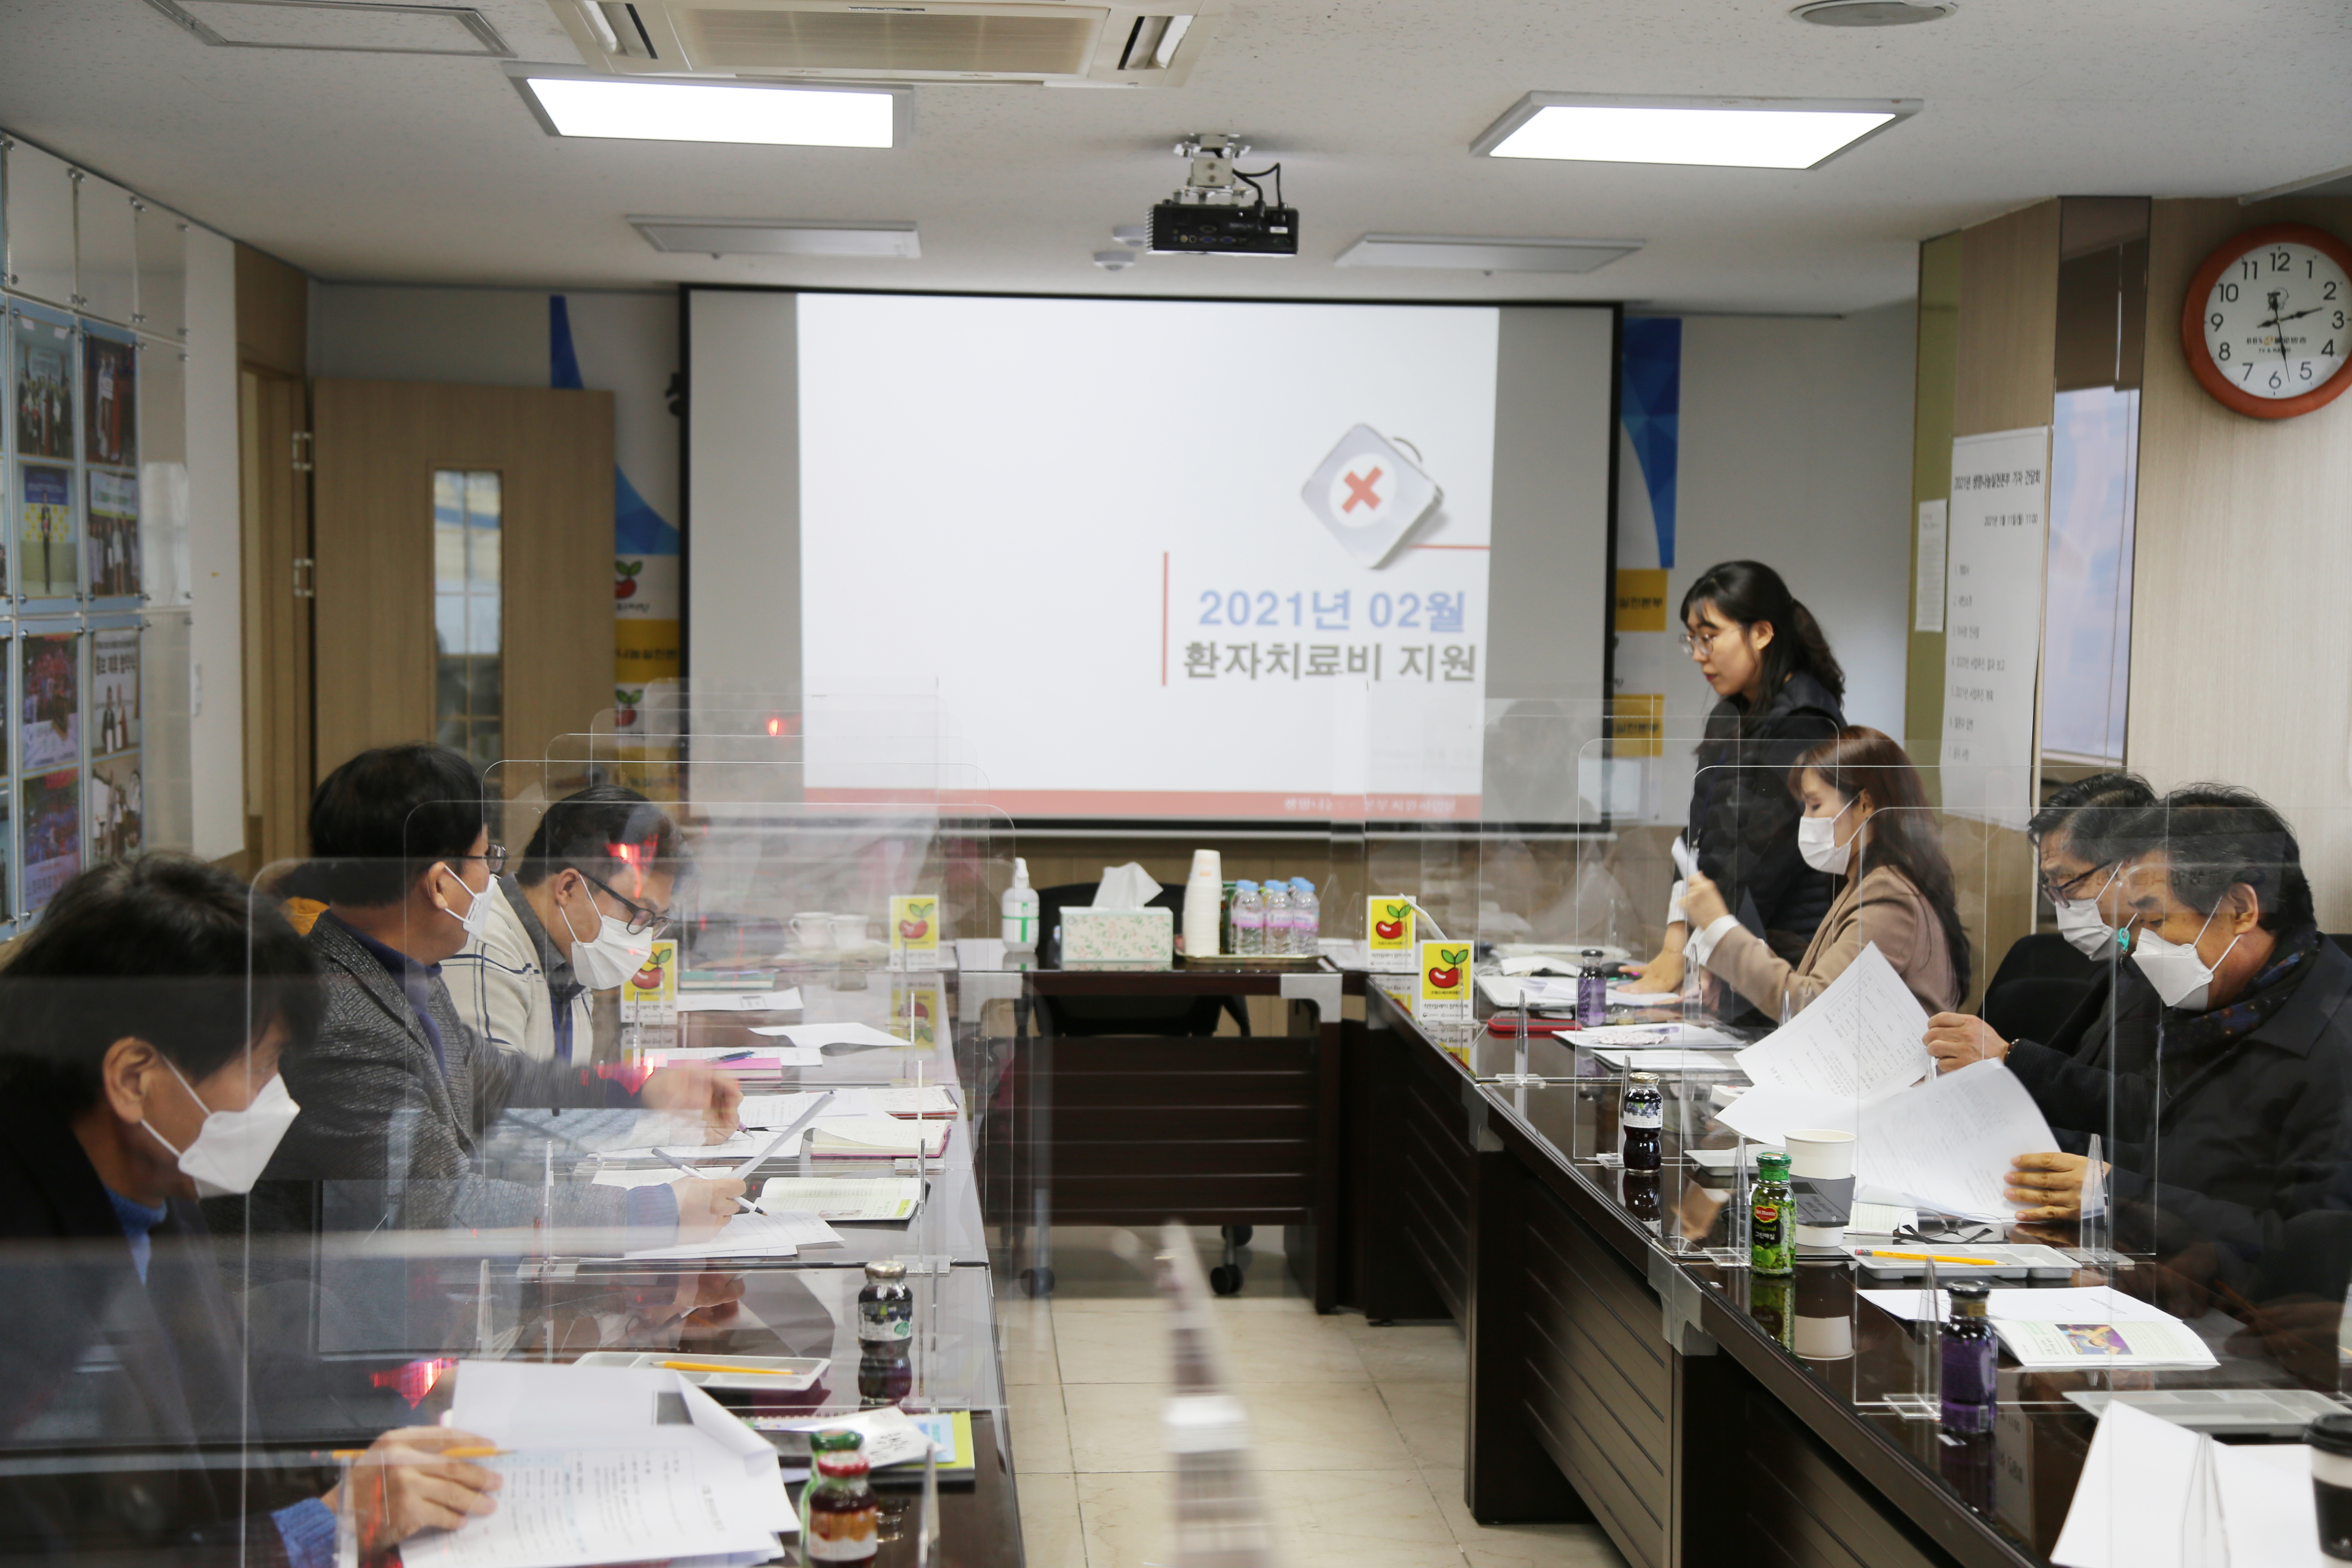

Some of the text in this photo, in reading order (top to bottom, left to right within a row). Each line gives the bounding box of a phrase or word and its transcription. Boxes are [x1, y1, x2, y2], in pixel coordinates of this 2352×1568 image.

[2242, 260, 2258, 280] 11
[2269, 252, 2291, 272] 12
[2306, 260, 2313, 279] 1
[2218, 283, 2239, 303] 10
[2324, 282, 2337, 300] 2
[2211, 312, 2224, 332] 9
[2332, 311, 2345, 330] 3
[2219, 342, 2231, 361] 8
[2321, 339, 2335, 357] 4
[2242, 363, 2254, 381] 7
[2269, 371, 2282, 389] 6
[2300, 362, 2312, 380] 5
[1199, 589, 1465, 633] 2021년 02월
[1184, 641, 1475, 682] 환자치료비 지원
[1755, 1223, 1776, 1232] Original
[1755, 1231, 1775, 1240] 그린매실
